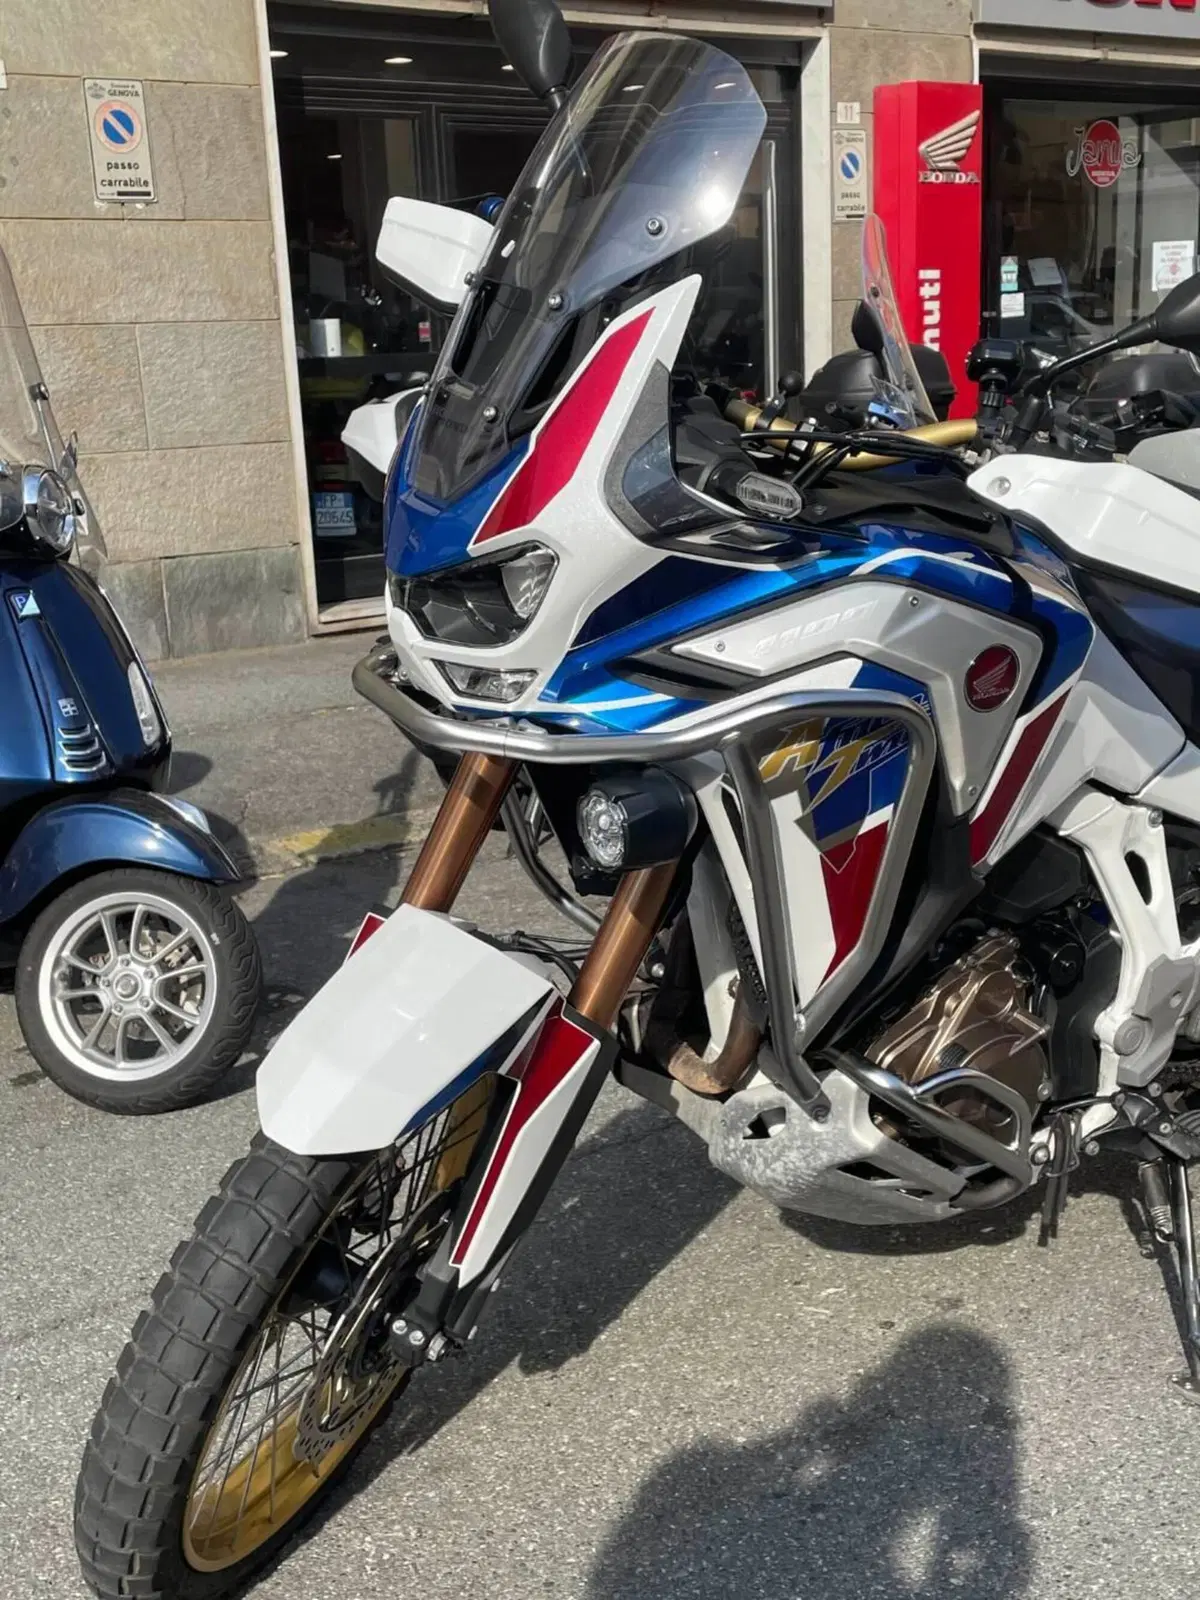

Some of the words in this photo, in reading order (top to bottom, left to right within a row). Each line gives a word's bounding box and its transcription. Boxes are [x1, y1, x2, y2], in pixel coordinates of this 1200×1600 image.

[108, 89, 140, 97] GENOVA
[844, 105, 854, 121] 11
[106, 161, 140, 172] passo
[100, 177, 149, 188] carrabile
[918, 171, 981, 184] HONDA
